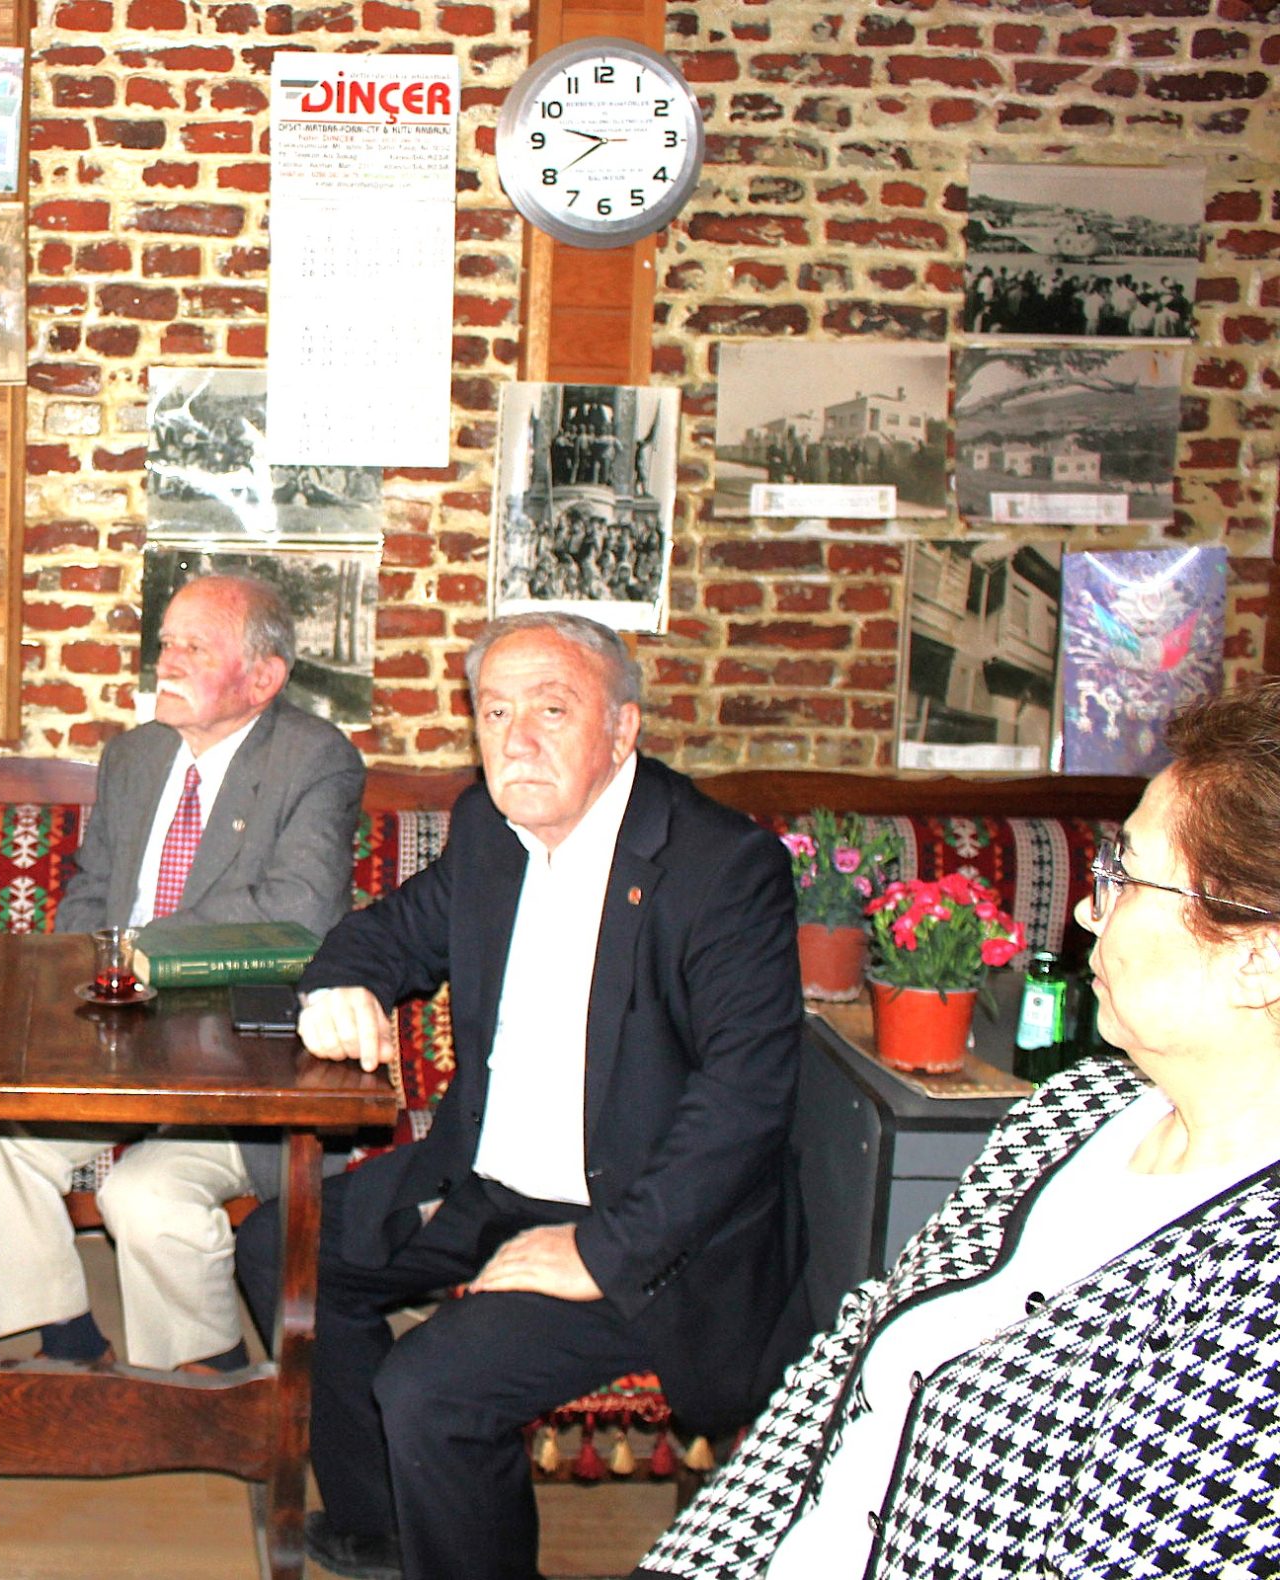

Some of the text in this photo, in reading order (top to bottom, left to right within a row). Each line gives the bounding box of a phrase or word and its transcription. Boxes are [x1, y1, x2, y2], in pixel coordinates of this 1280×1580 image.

[594, 66, 614, 83] 12
[567, 77, 578, 94] 11
[636, 76, 640, 93] 1
[301, 71, 451, 124] DİNÇER
[542, 101, 563, 118] 10
[654, 100, 669, 117] 2
[531, 132, 546, 149] 9
[664, 131, 677, 148] 3
[542, 168, 558, 185] 8
[653, 166, 668, 183] 4
[566, 190, 580, 207] 7
[631, 189, 644, 206] 5
[597, 198, 612, 215] 6
